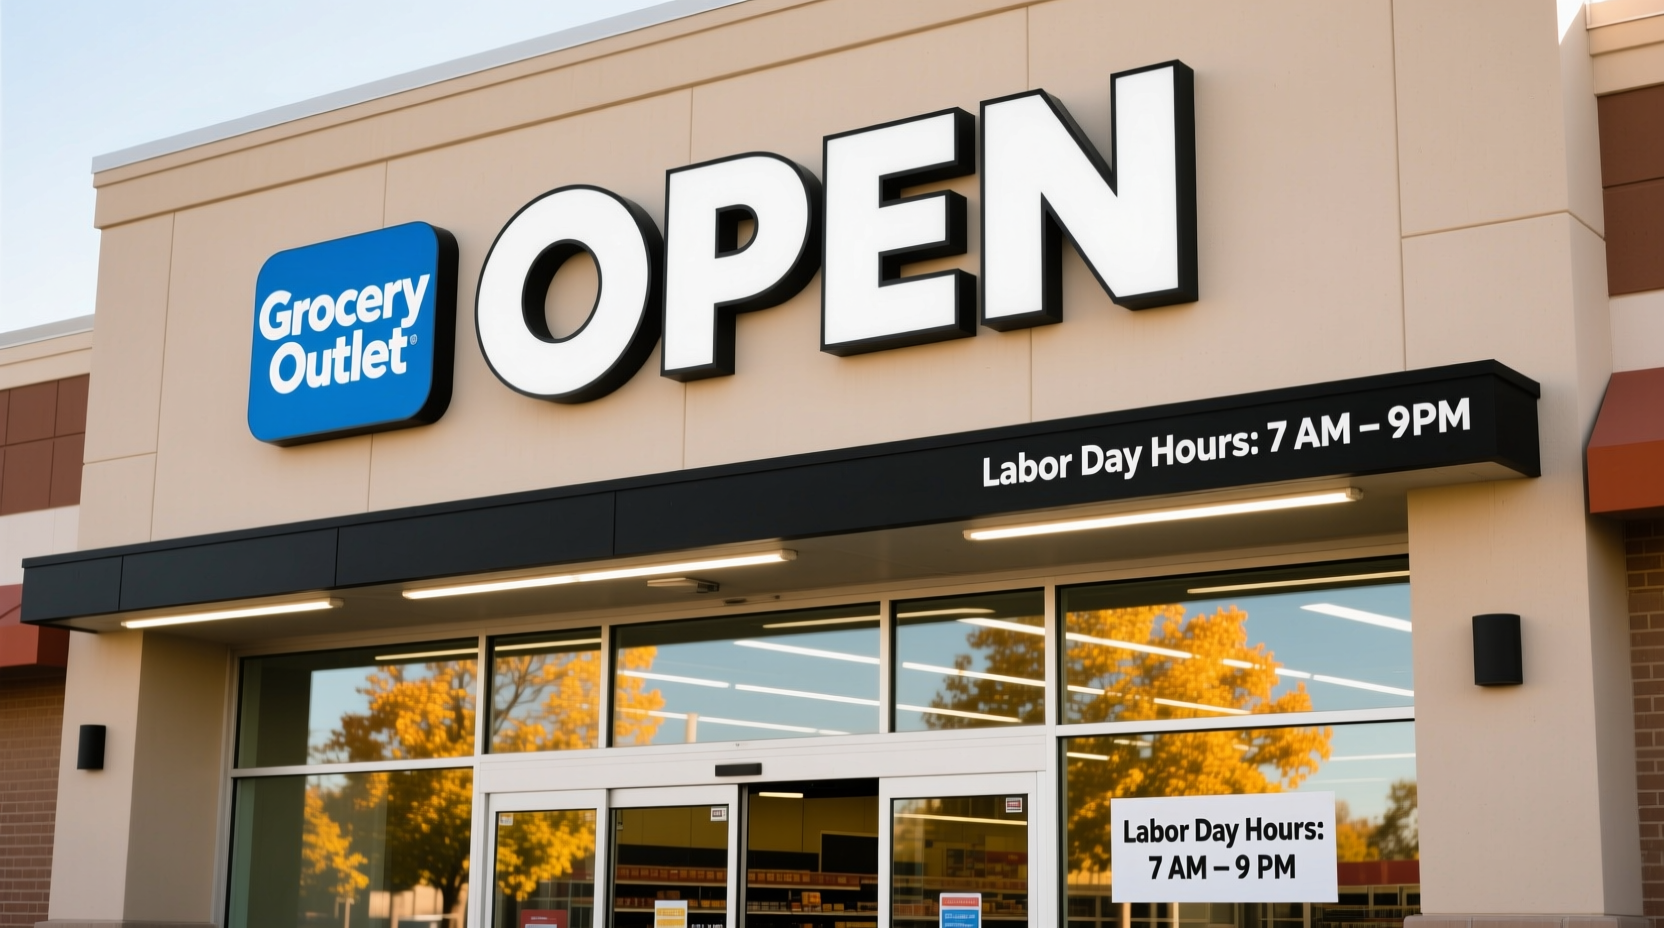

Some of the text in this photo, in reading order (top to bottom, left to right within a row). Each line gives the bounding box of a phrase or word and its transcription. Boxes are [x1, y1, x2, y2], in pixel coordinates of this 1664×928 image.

[475, 60, 1197, 403] OPEN
[259, 273, 431, 341] Grocery
[983, 451, 1073, 487] Labor
[1081, 444, 1143, 479] Day
[1151, 430, 1259, 467] Hours:
[1267, 420, 1288, 453] 7
[1294, 412, 1351, 450] AM
[1123, 816, 1324, 849] Labor Day Hours:
[1148, 855, 1163, 880] 7
[1168, 855, 1207, 880] AM
[1235, 854, 1250, 880] 9
[1257, 854, 1296, 880] PM
